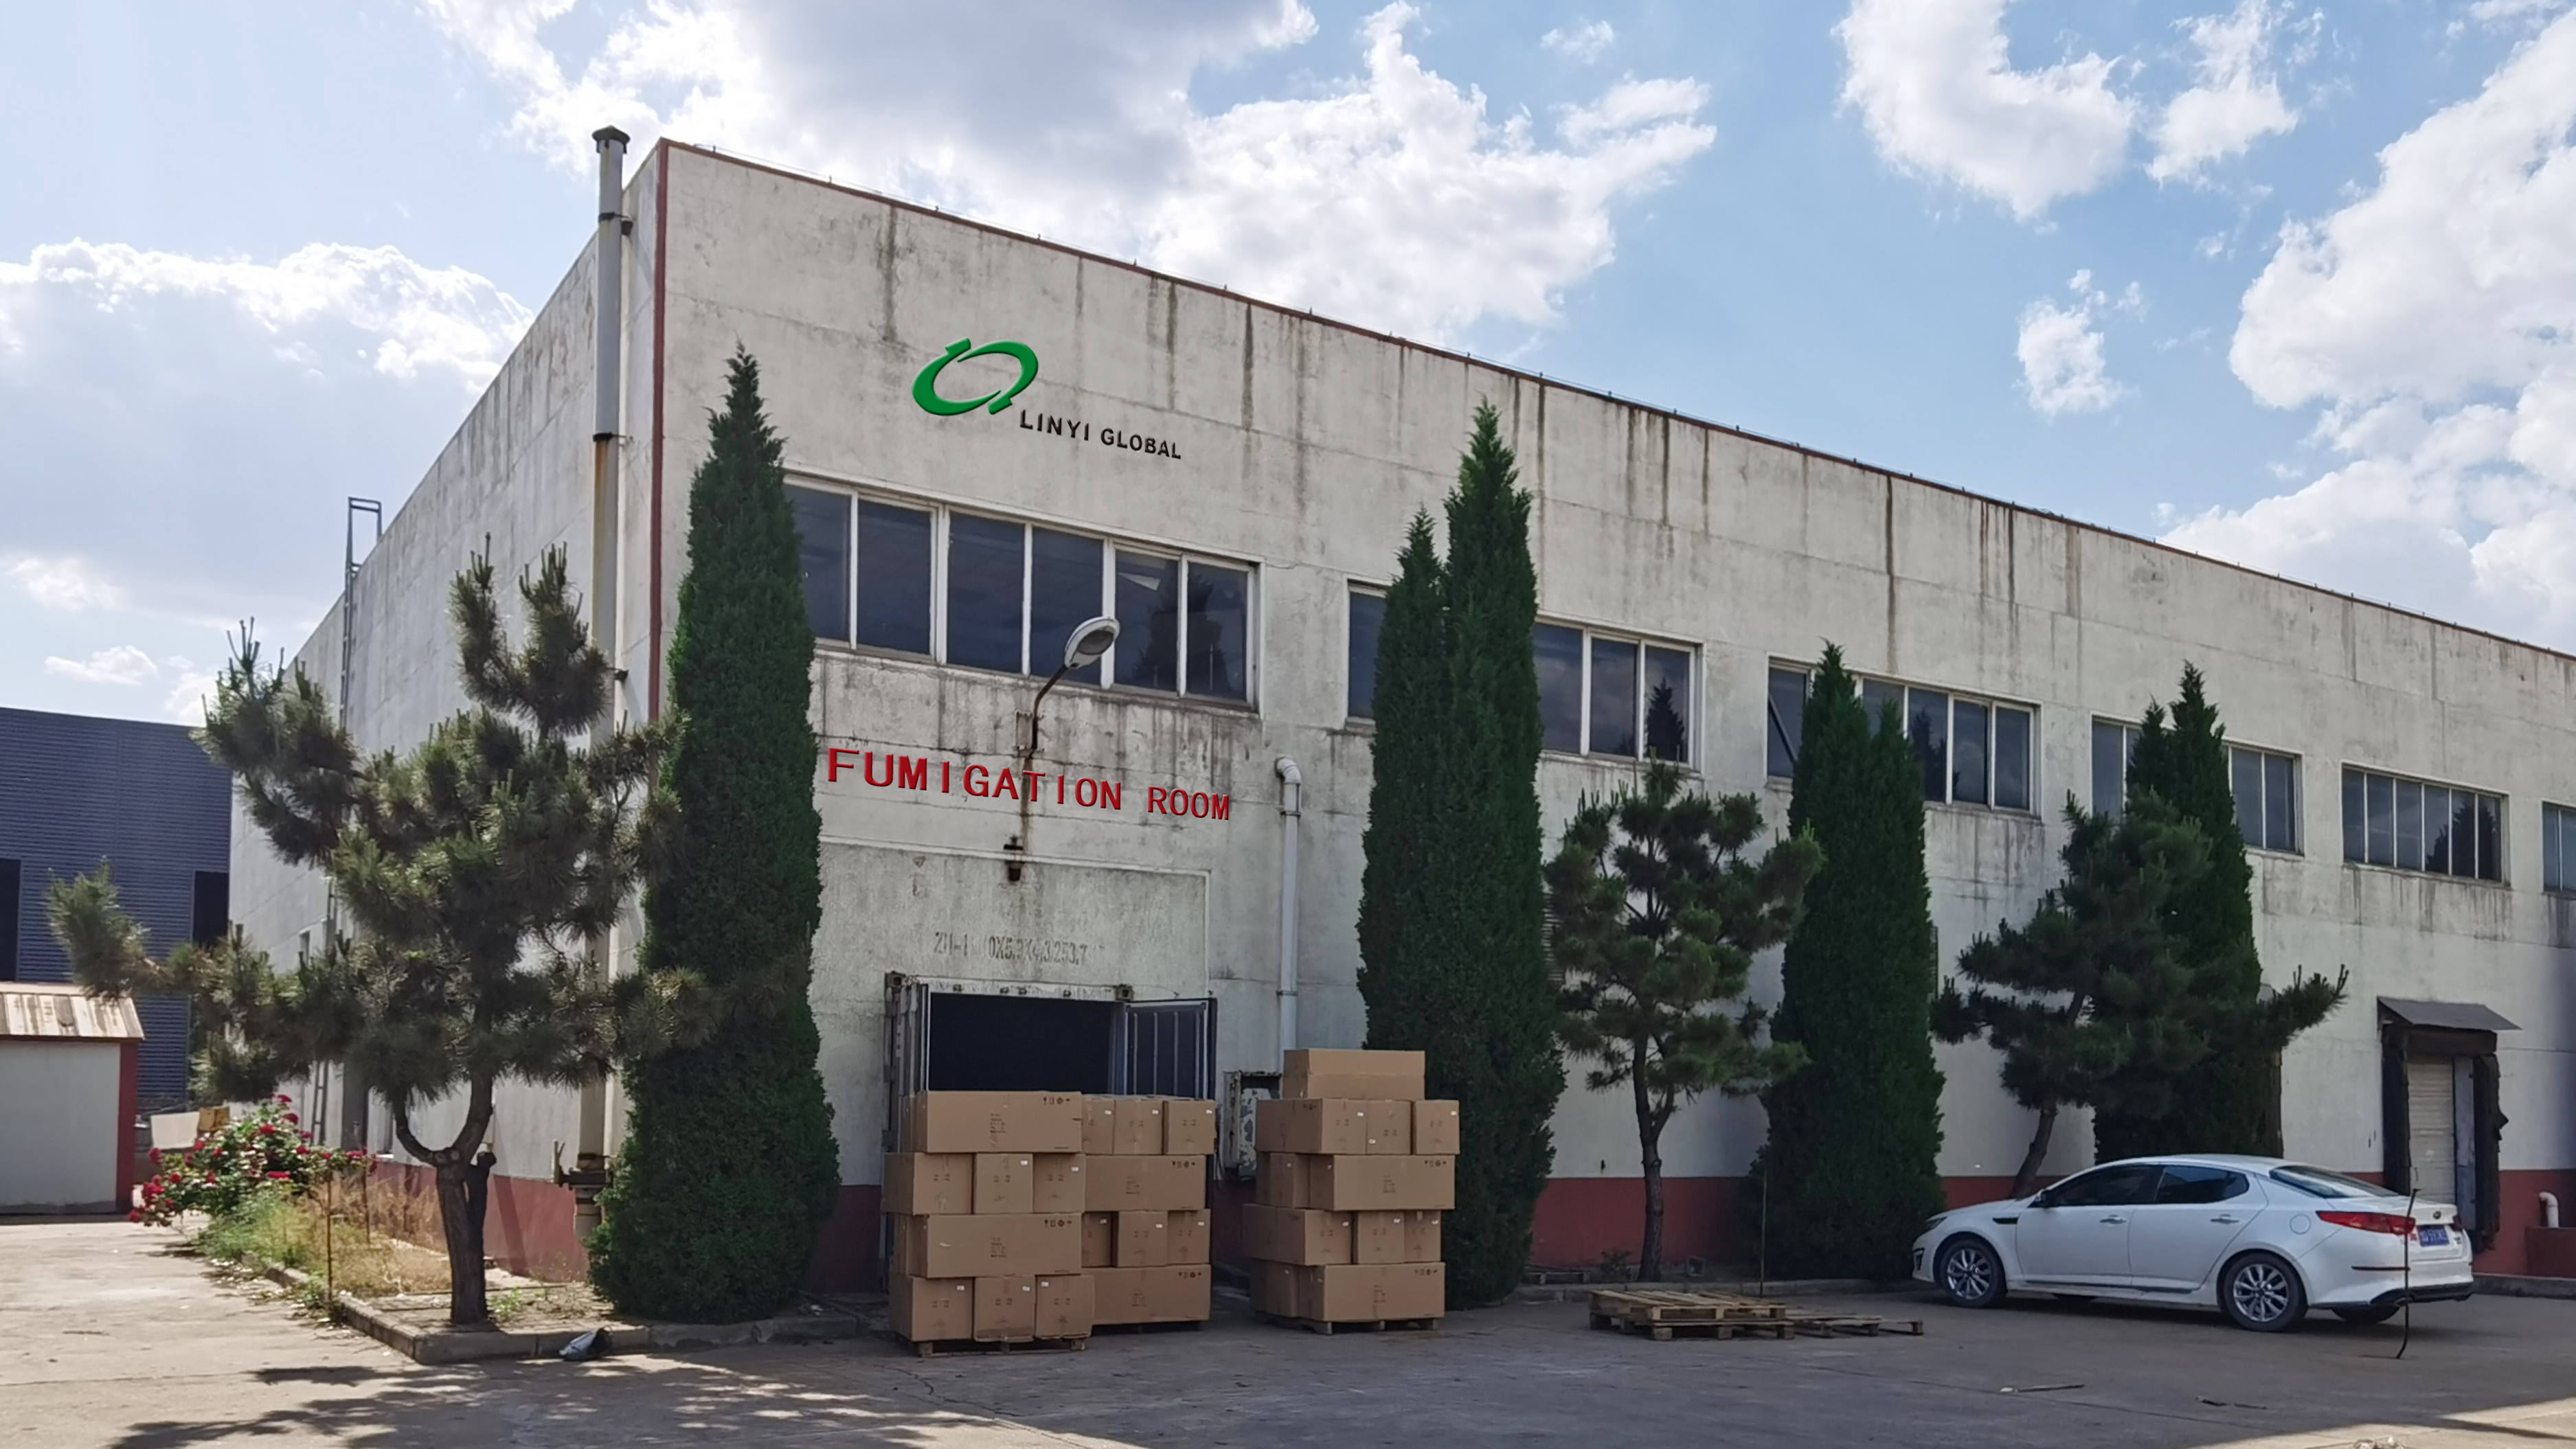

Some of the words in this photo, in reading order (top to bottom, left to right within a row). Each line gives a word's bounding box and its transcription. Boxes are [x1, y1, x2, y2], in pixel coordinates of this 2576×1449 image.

[1019, 410, 1089, 441] LINYI
[1100, 427, 1182, 459] GLOBAL
[828, 746, 1121, 810] FUMIGATION
[1147, 785, 1230, 821] ROOM
